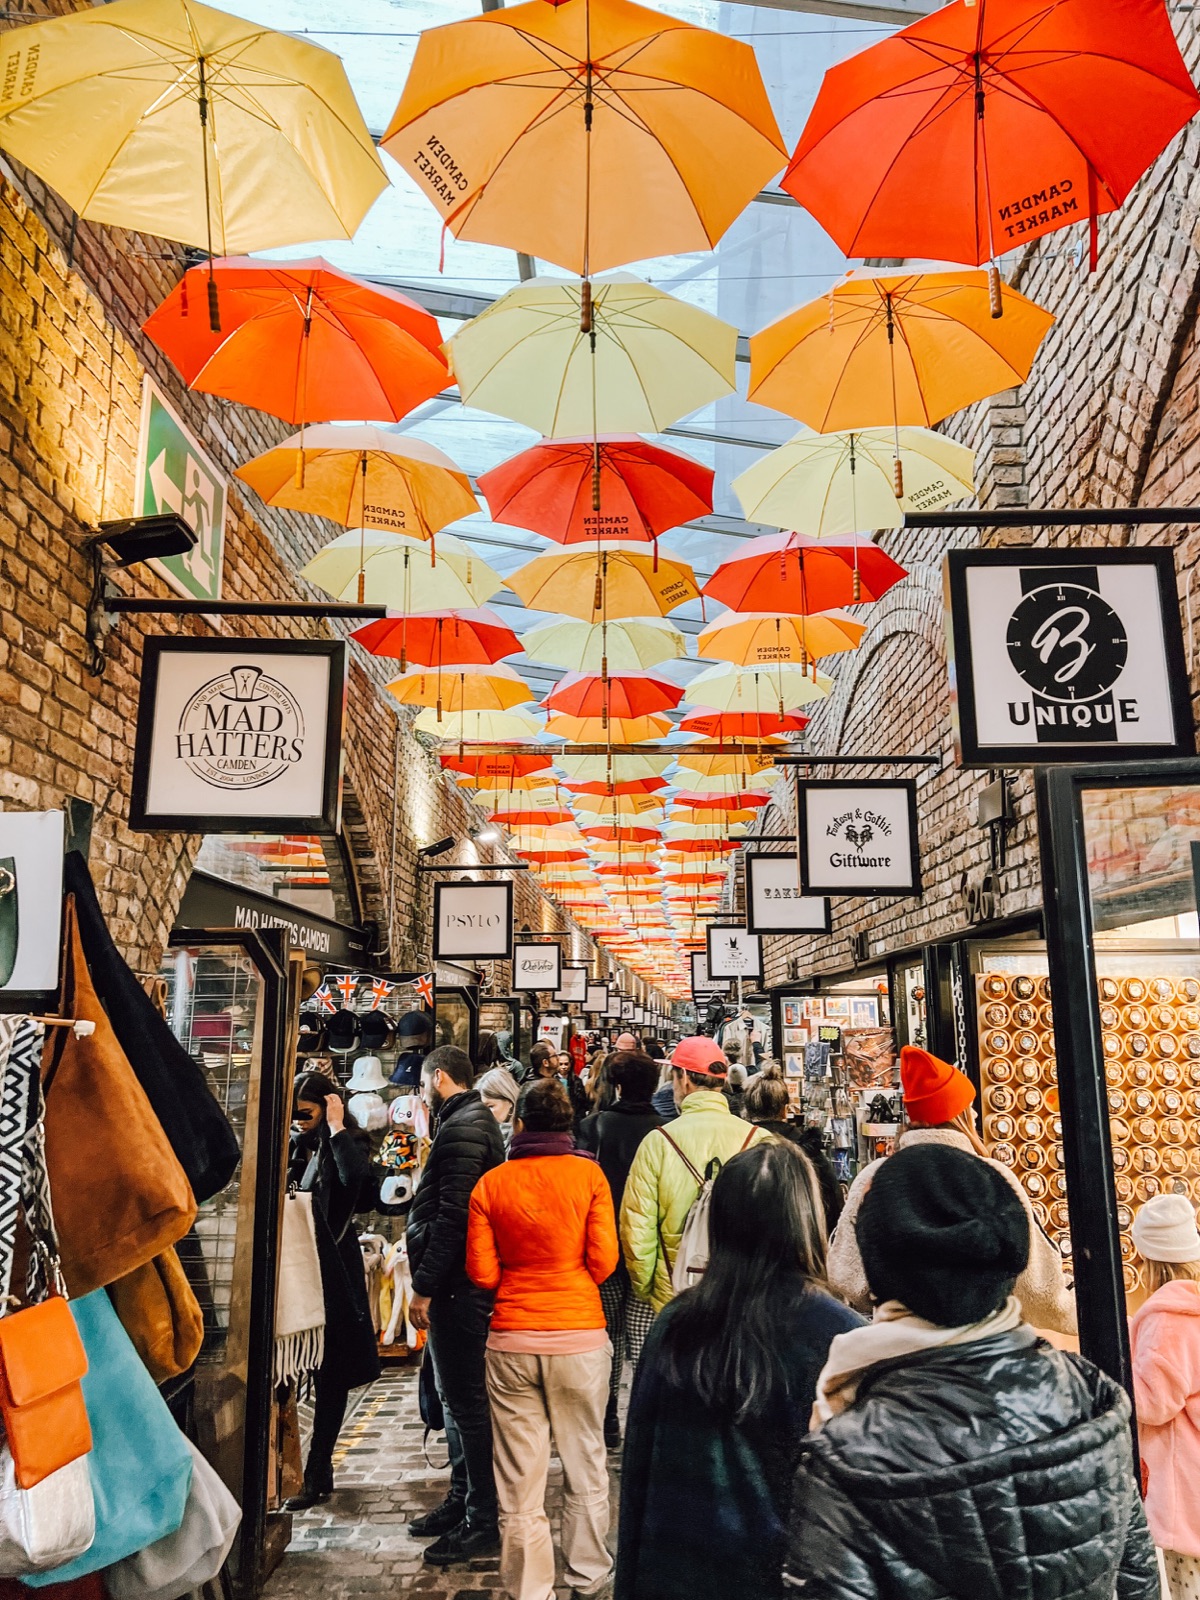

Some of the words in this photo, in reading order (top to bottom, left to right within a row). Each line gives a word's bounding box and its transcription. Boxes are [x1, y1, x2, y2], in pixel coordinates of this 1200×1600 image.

[1031, 605, 1097, 683] B
[192, 694, 208, 712] HAND
[207, 683, 225, 696] MADE
[258, 682, 283, 699] CUSTOM
[280, 697, 293, 715] HATS
[200, 703, 284, 733] MAD
[1007, 698, 1140, 728] UNIQUE
[175, 732, 305, 763] HATTERS
[205, 767, 218, 778] EST
[219, 774, 234, 782] 2004
[242, 770, 270, 783] LONDON
[216, 758, 258, 770] CAMDEN
[826, 812, 853, 837] Fantasy
[855, 807, 862, 819] &
[864, 810, 892, 837] Gothic
[829, 852, 891, 868] Giftware
[235, 905, 260, 930] MAD
[300, 926, 331, 954] CAMDEN
[446, 914, 501, 928] PSYLO
